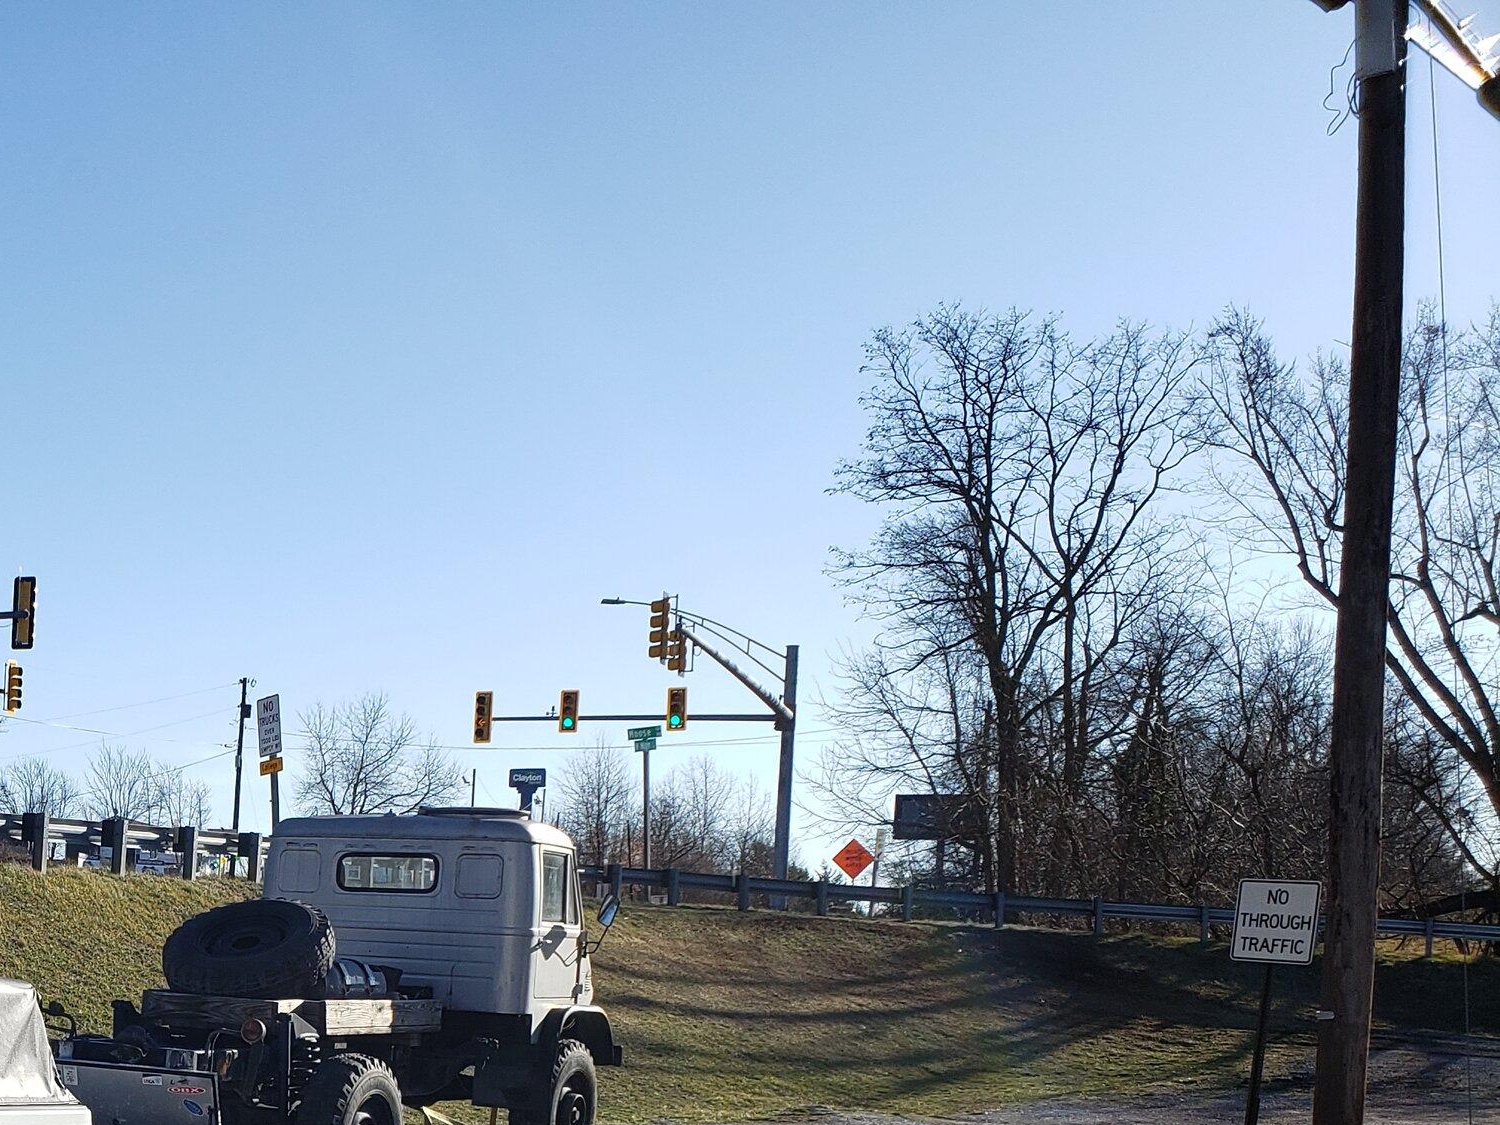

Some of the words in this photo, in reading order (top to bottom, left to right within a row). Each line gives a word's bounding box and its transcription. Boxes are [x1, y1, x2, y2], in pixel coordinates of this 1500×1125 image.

[263, 701, 274, 713] NO
[260, 714, 279, 726] TRUCKS
[513, 774, 542, 783] Clayton
[1267, 889, 1289, 905] NO
[1241, 912, 1312, 930] THROUGH
[1241, 936, 1304, 954] TRAFFIC
